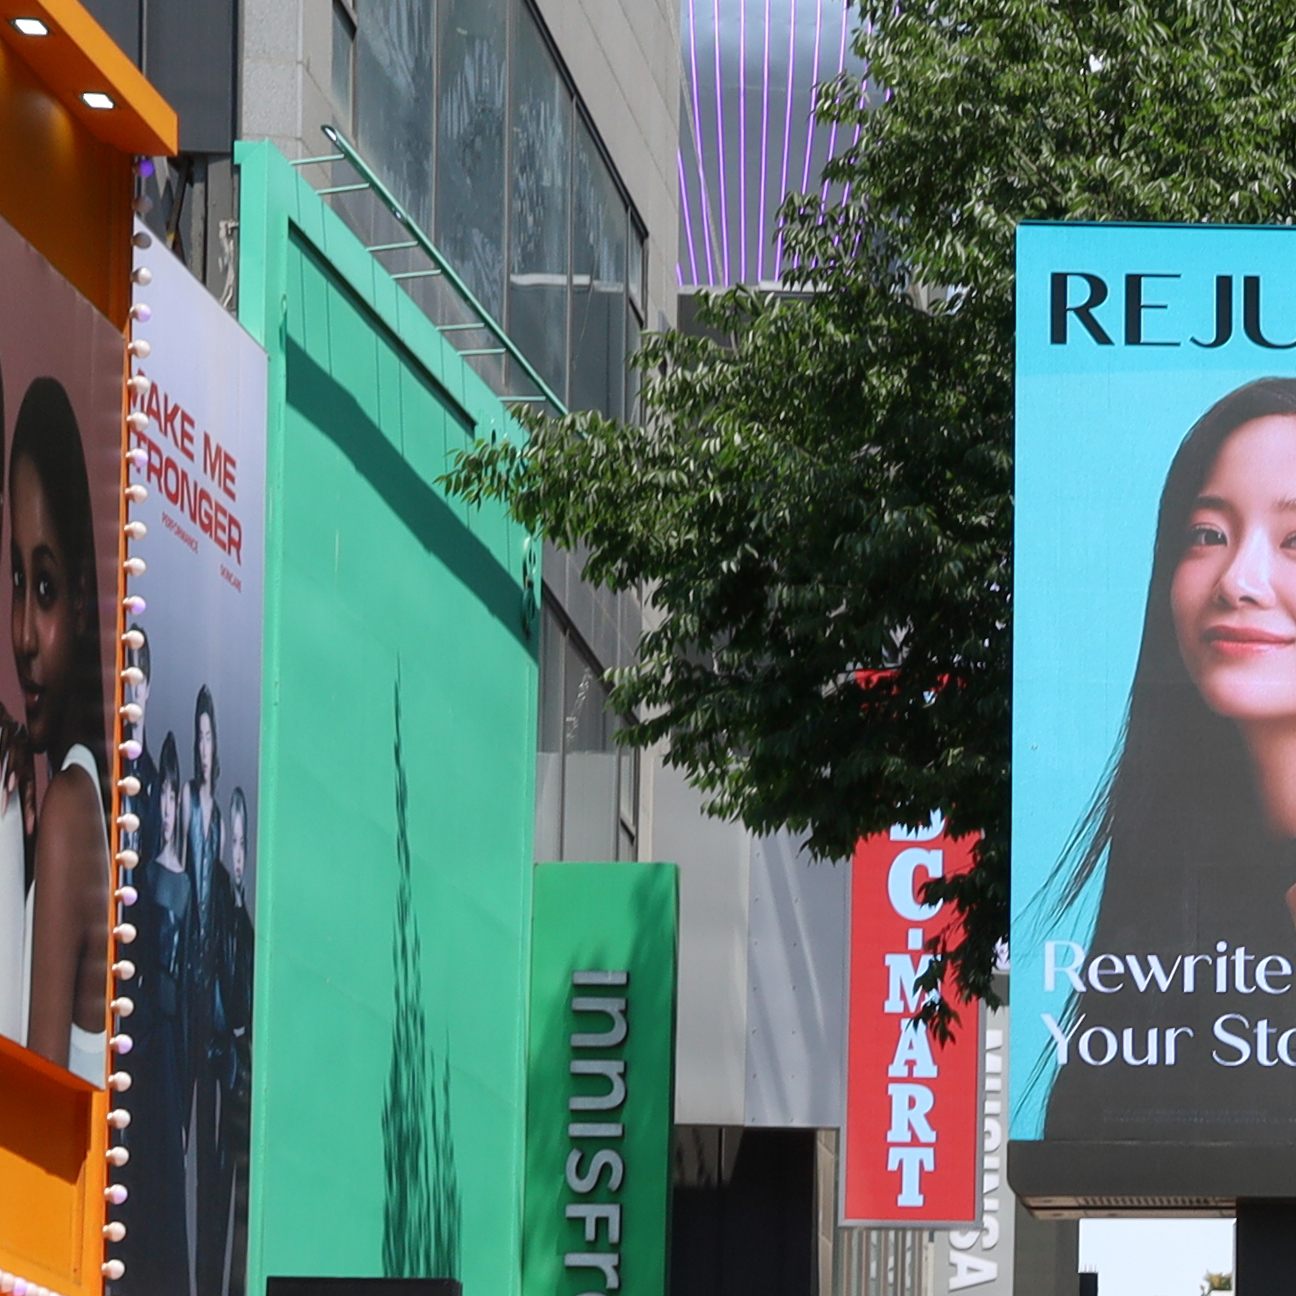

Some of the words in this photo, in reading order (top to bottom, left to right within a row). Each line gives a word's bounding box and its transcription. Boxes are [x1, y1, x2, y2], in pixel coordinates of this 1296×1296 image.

[203, 431, 237, 502] ME
[1042, 940, 1293, 996] Rewrite
[1041, 1013, 1193, 1067] Your
